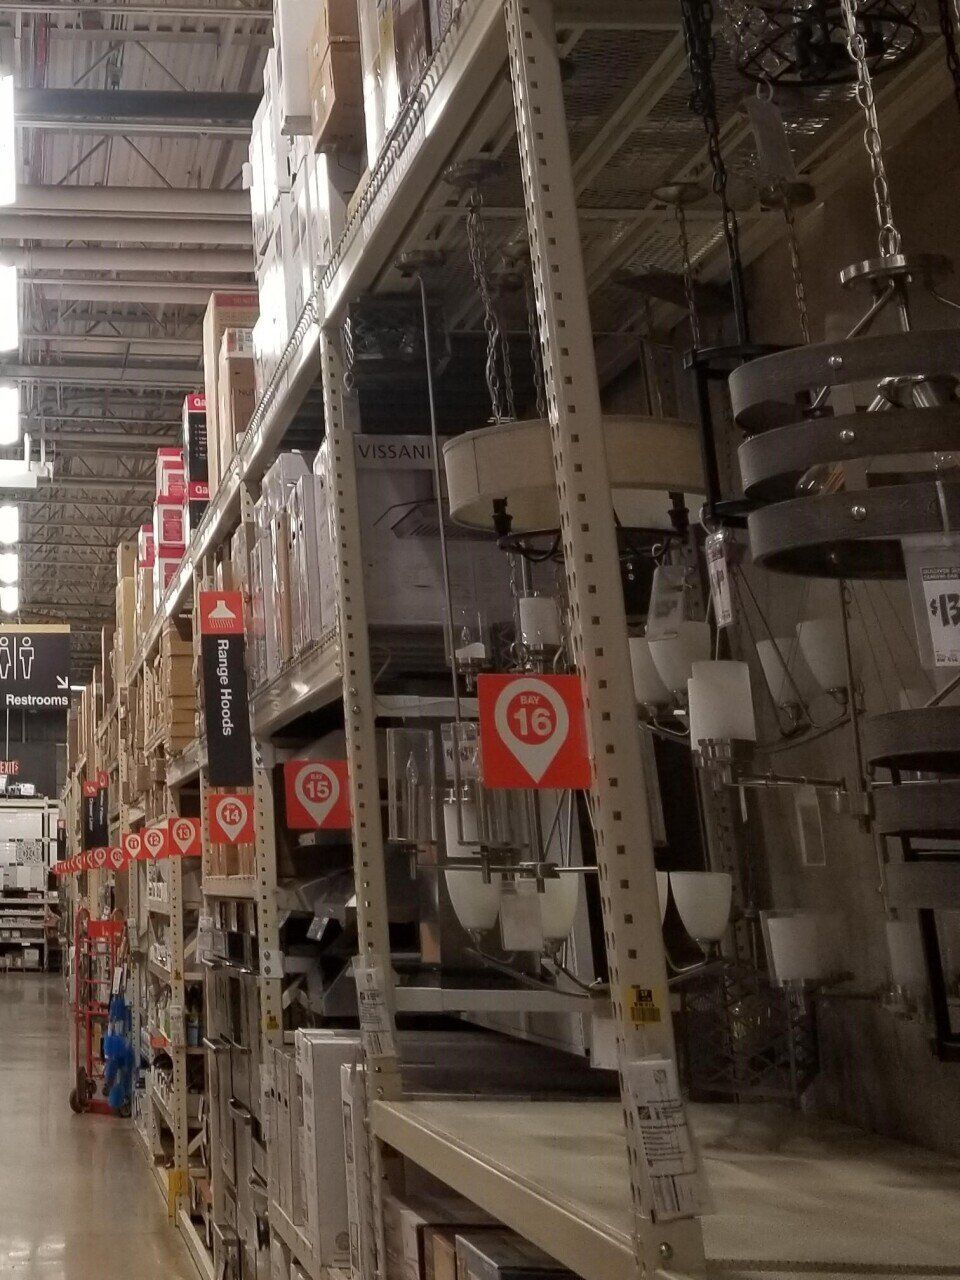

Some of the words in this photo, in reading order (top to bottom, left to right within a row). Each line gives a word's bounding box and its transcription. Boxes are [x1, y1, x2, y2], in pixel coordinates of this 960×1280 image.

[358, 444, 431, 459] VISSANI
[217, 639, 229, 686] Range
[5, 693, 69, 706] Restrooms
[520, 695, 540, 705] BAY
[220, 688, 233, 736] Hoods
[513, 707, 552, 736] 16
[0, 761, 15, 774] EXIT
[305, 781, 330, 798] 15
[223, 808, 240, 823] 14
[178, 829, 190, 839] 13
